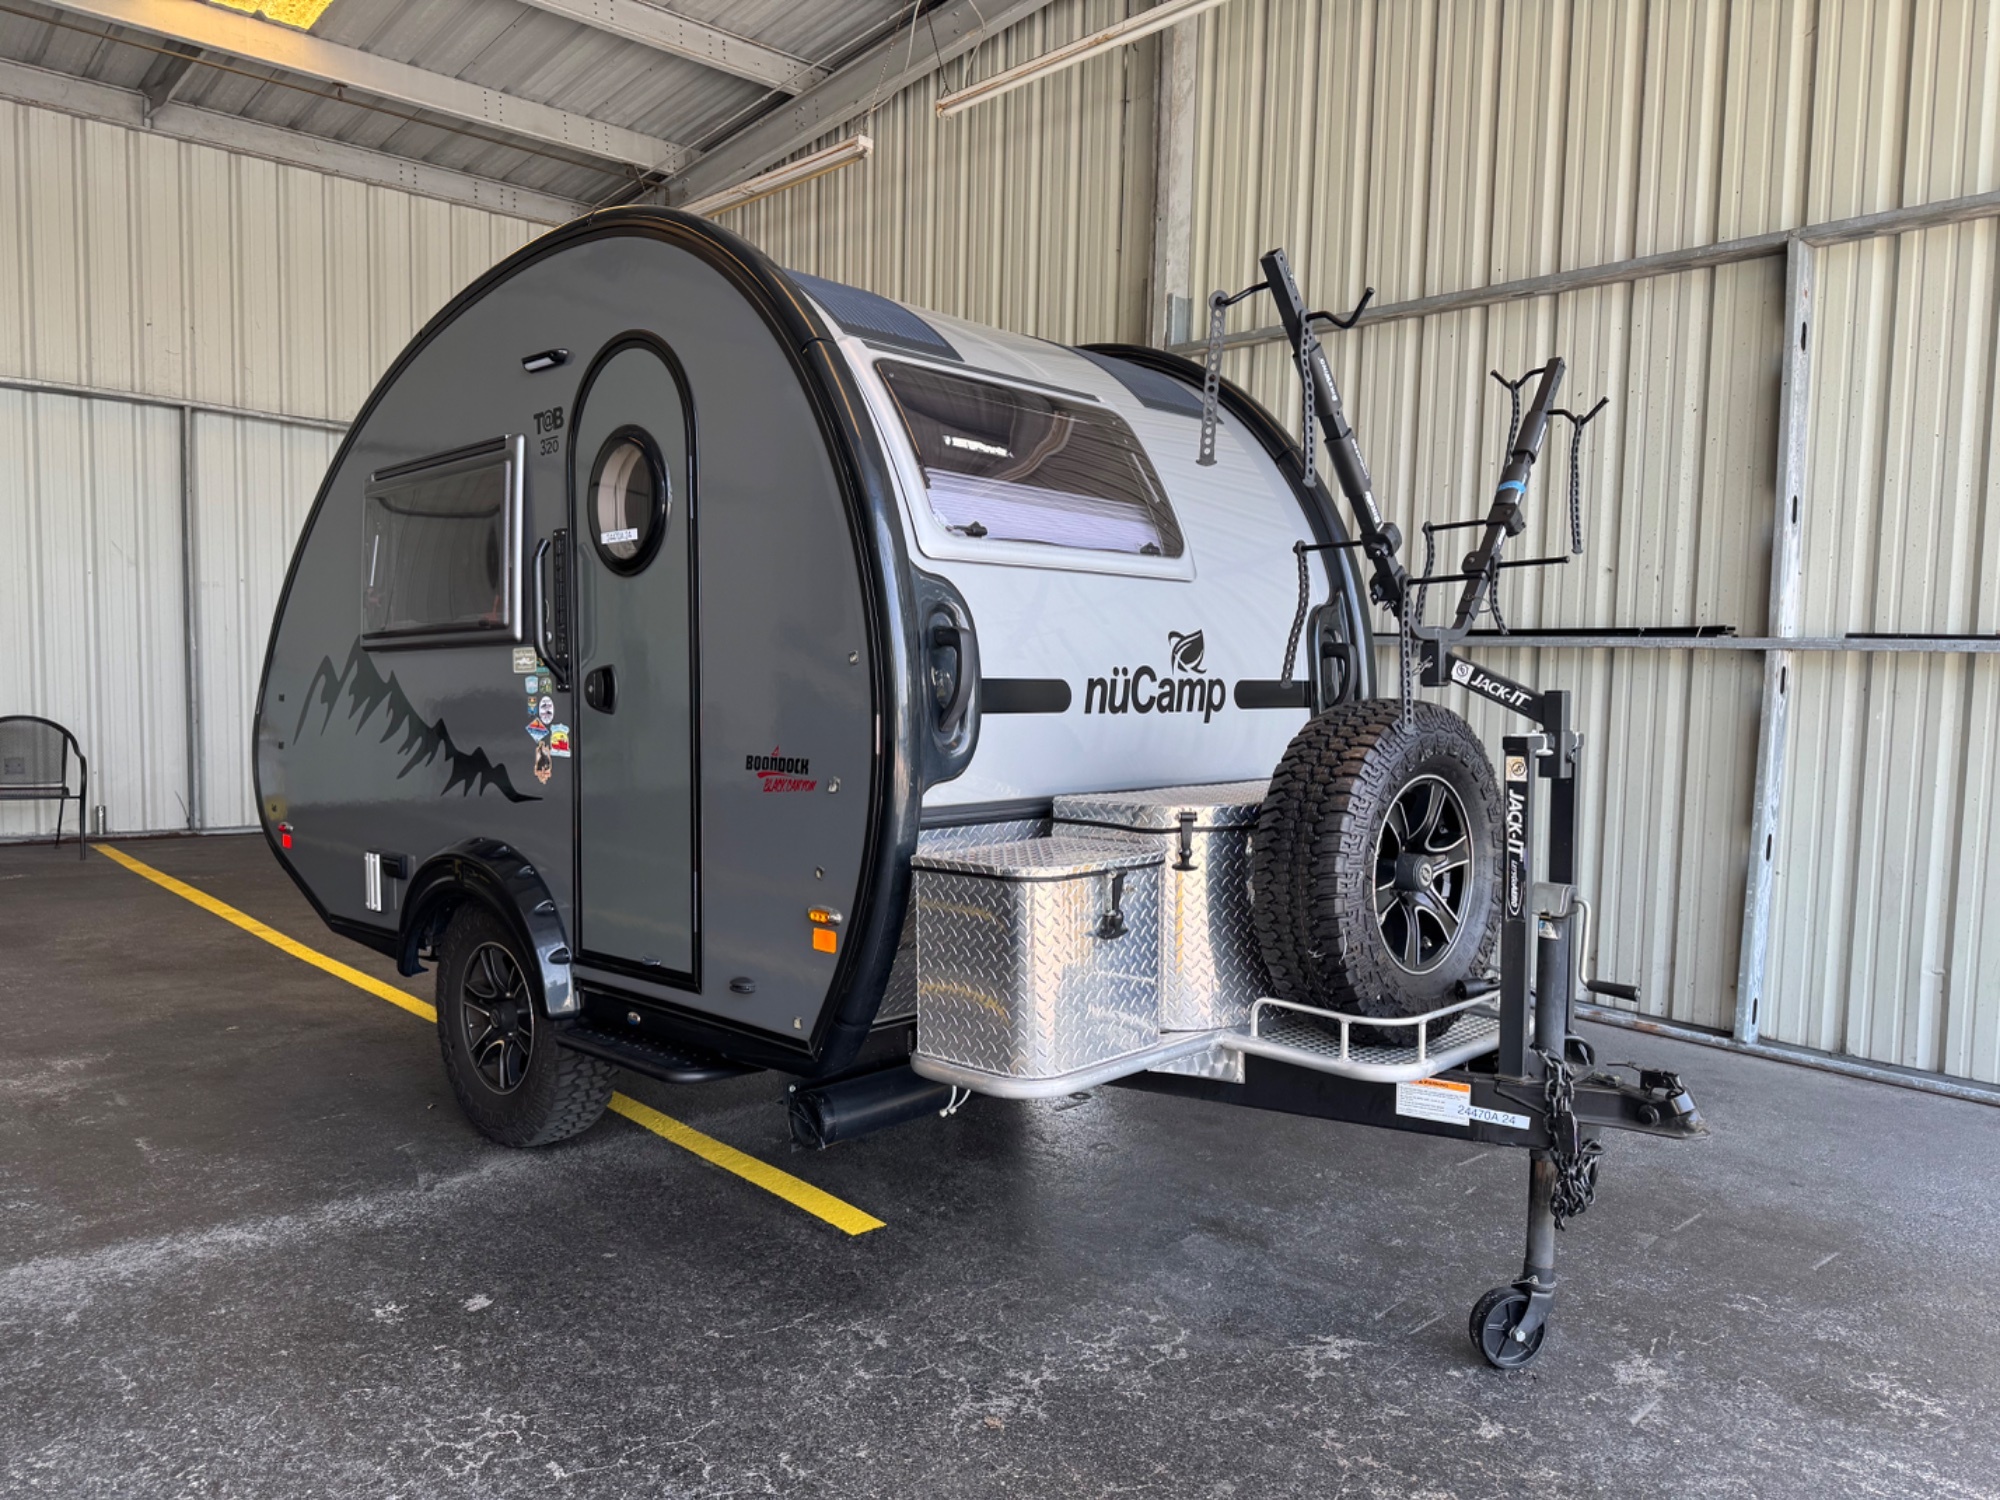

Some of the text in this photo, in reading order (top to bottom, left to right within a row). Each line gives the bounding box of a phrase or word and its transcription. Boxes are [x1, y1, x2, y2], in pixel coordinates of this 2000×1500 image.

[533, 406, 564, 435] T@B
[540, 439, 560, 456] 320
[1084, 665, 1226, 724] nüCamp
[1470, 674, 1532, 706] JACK-IT
[745, 755, 809, 775] BOONDOCK
[763, 778, 786, 793] BLACK
[1508, 789, 1525, 860] JACK-IT
[1457, 1105, 1516, 1126] 24470A 24
